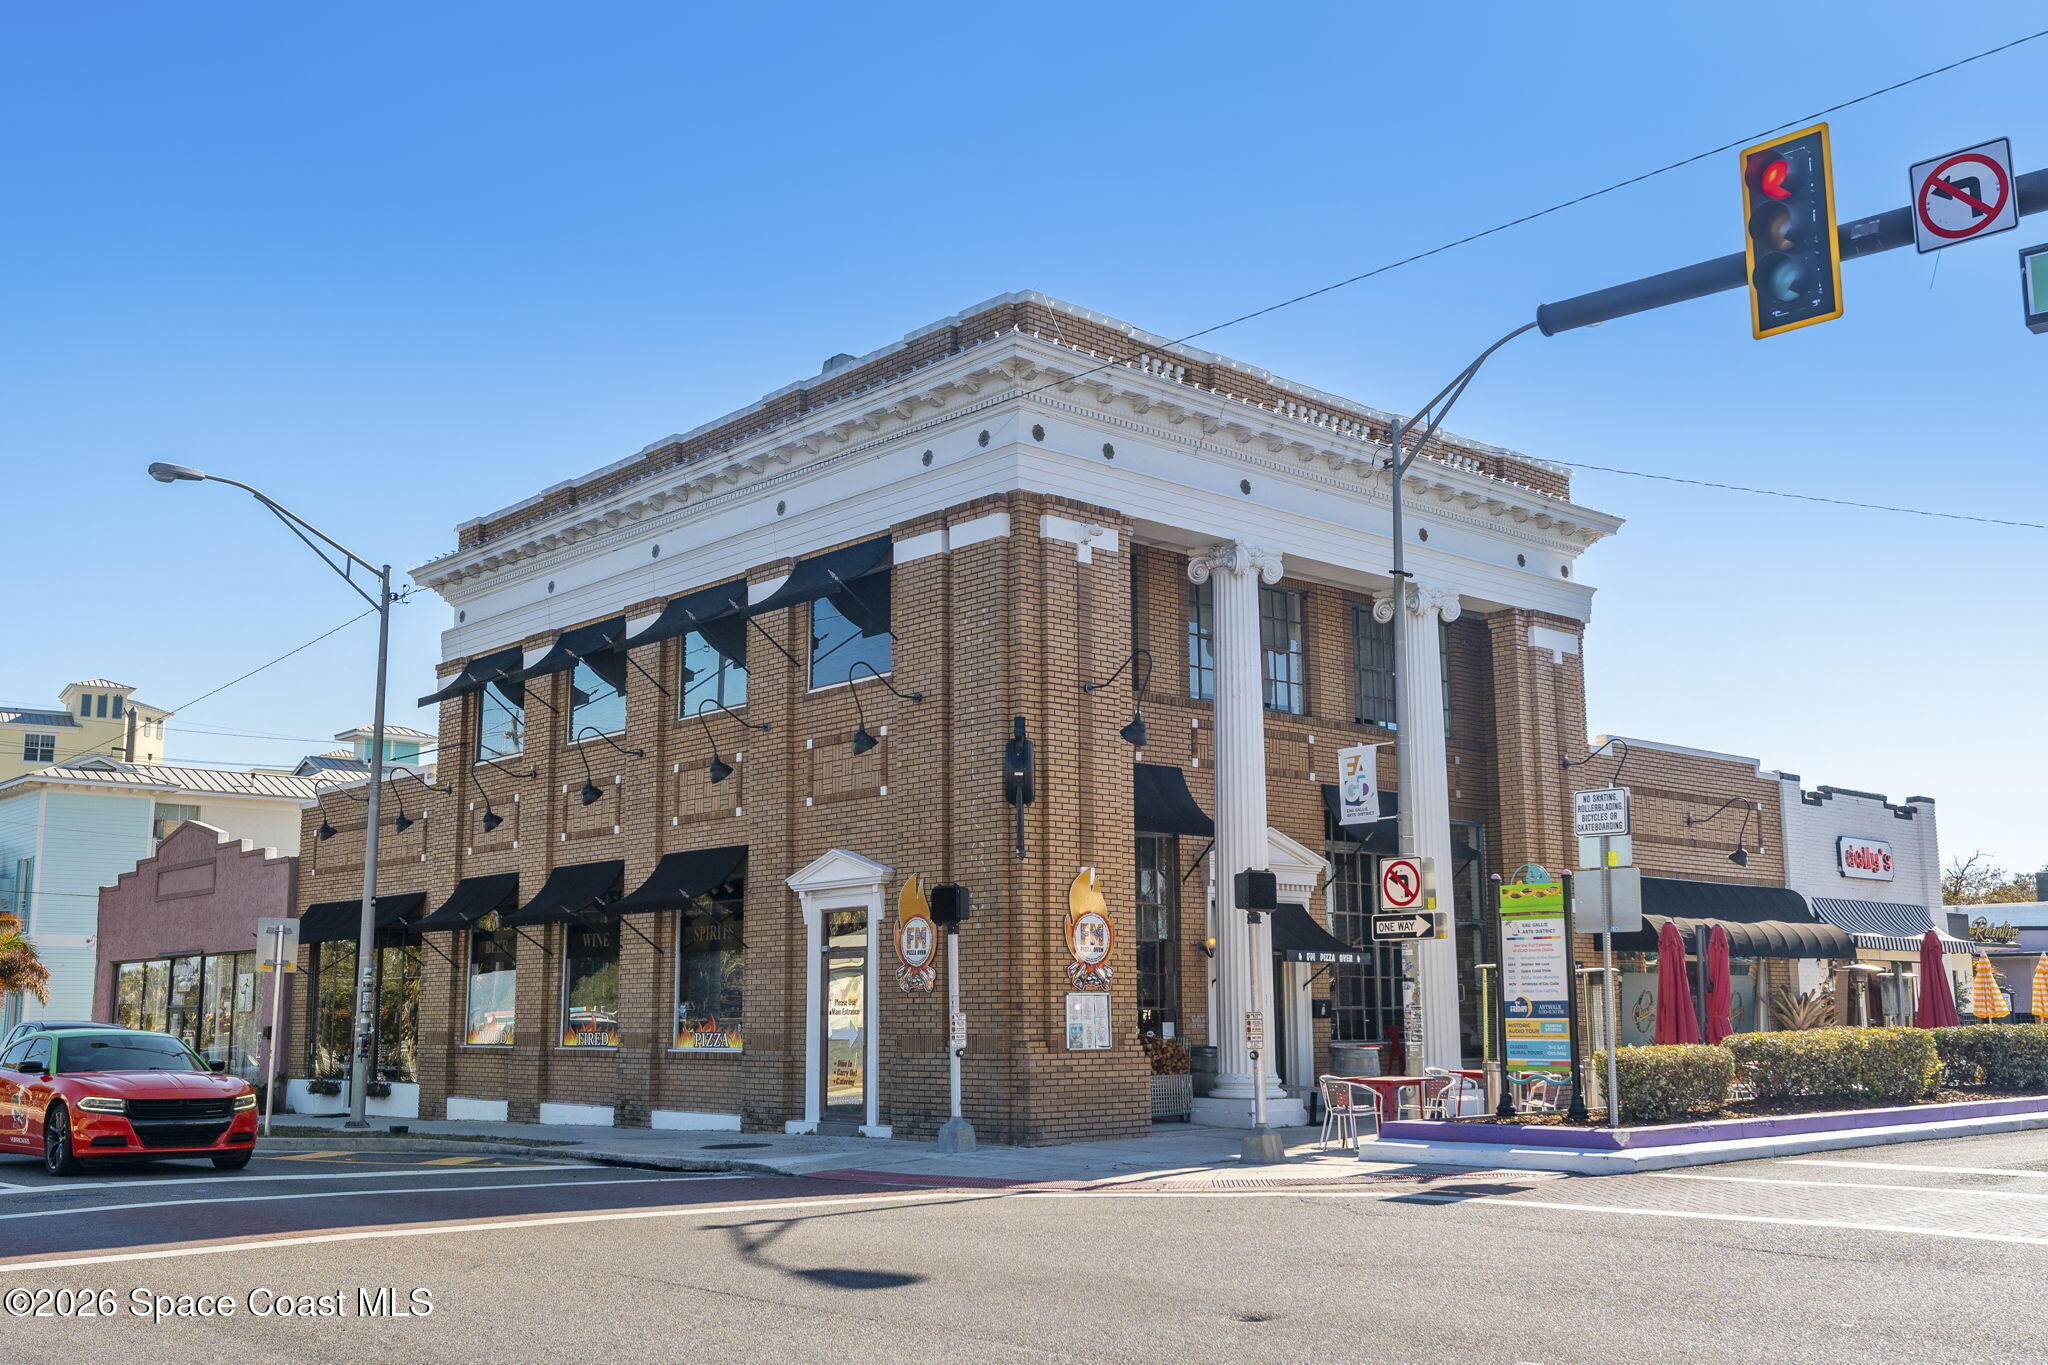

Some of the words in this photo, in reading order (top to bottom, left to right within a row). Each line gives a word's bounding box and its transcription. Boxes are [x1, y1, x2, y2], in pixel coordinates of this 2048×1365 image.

[1583, 795, 1591, 803] NO
[1582, 813, 1608, 822] BICYCLES
[1610, 812, 1618, 820] OR
[1578, 821, 1623, 832] SKATEBOARDING
[1845, 845, 1893, 873] dolly's
[694, 925, 735, 940] SPIRITS
[1379, 923, 1395, 932] ONE
[1398, 921, 1415, 931] WAY
[583, 933, 610, 948] WINE
[906, 927, 926, 949] FM
[1080, 923, 1103, 945] FM
[485, 940, 508, 953] BEER
[1306, 952, 1316, 961] FM
[1320, 953, 1335, 961] PIZZA
[1339, 954, 1353, 962] OVEN
[842, 1007, 860, 1015] Entrance
[480, 1031, 507, 1044] WOOD
[577, 1032, 609, 1046] FIRED
[694, 1032, 729, 1047] PIZZA
[837, 1068, 849, 1077] Carry
[850, 1068, 858, 1077] Out
[836, 1078, 855, 1087] Catering
